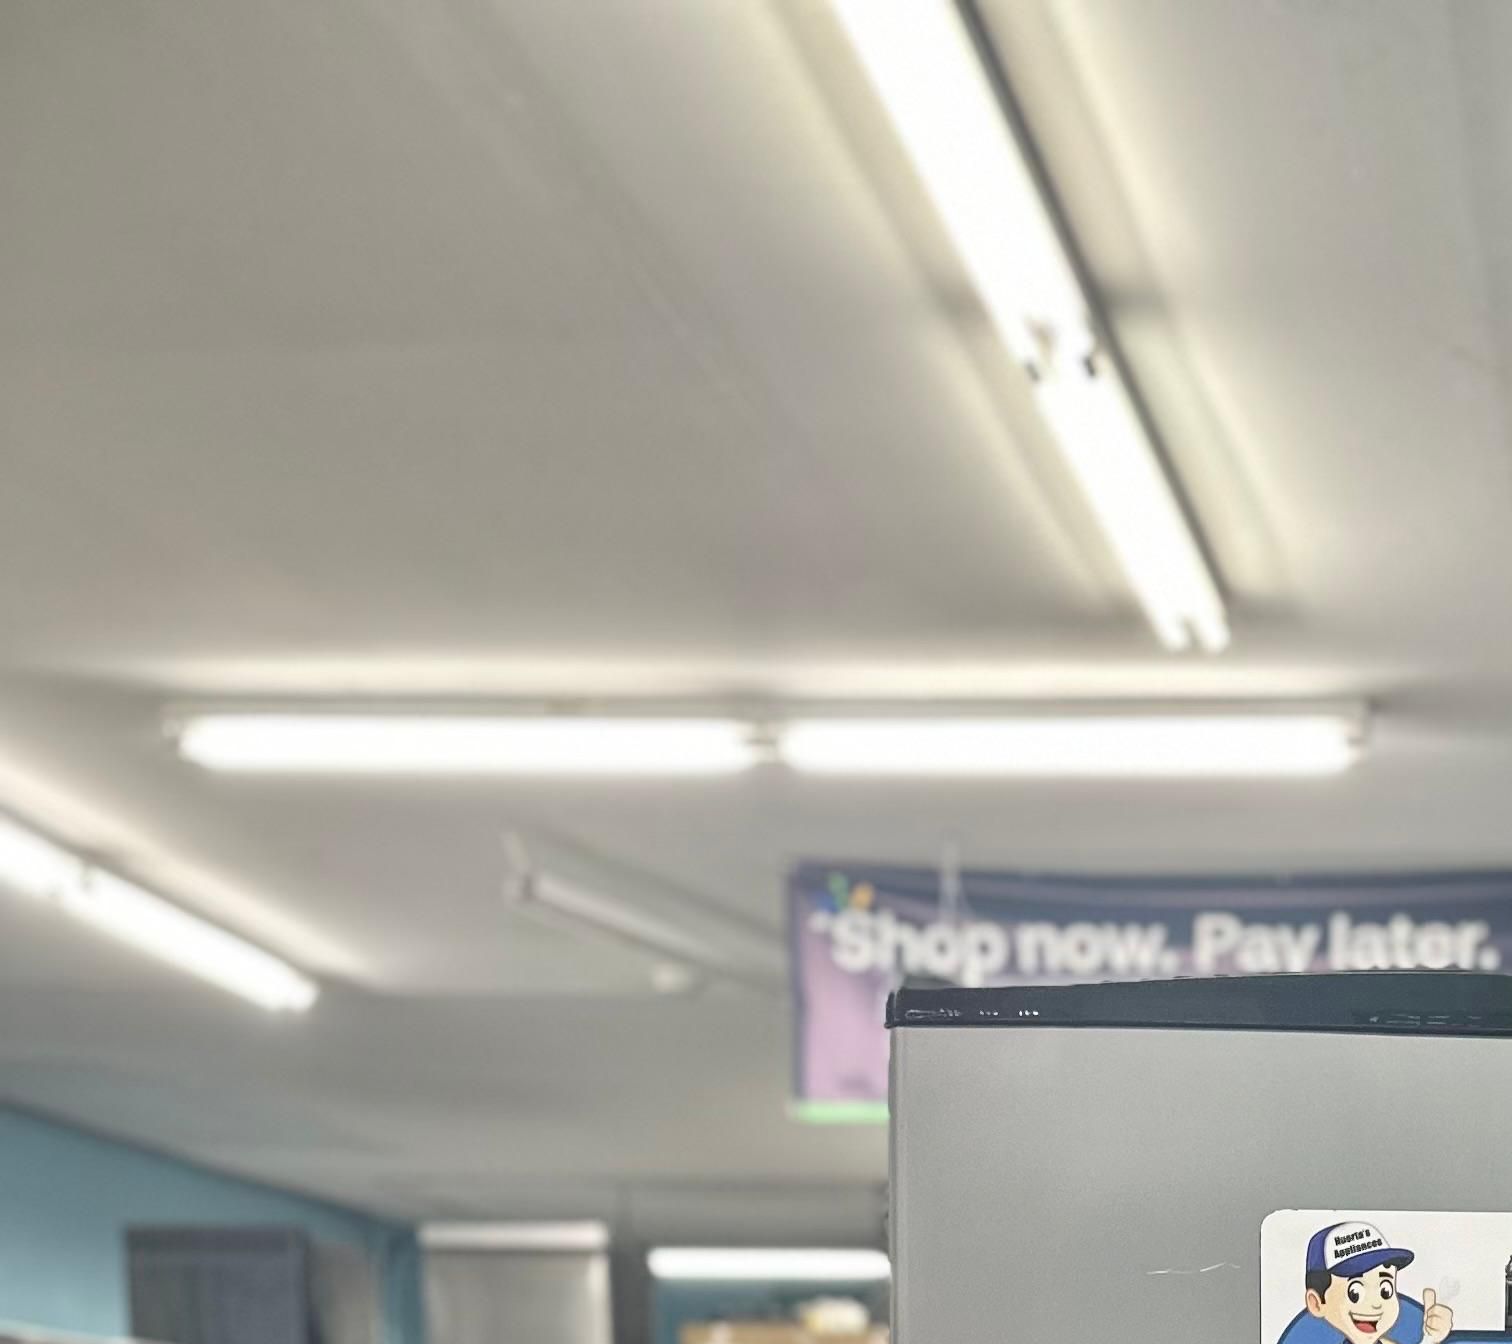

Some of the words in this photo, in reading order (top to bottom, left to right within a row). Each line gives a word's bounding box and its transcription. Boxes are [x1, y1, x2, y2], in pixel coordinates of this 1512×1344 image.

[831, 908, 1007, 988] Shop
[1015, 919, 1178, 973] now.
[1192, 911, 1320, 973] Pay
[1328, 910, 1500, 971] later.
[1334, 1229, 1371, 1246] Huerta's
[1334, 1239, 1383, 1259] Appliances
